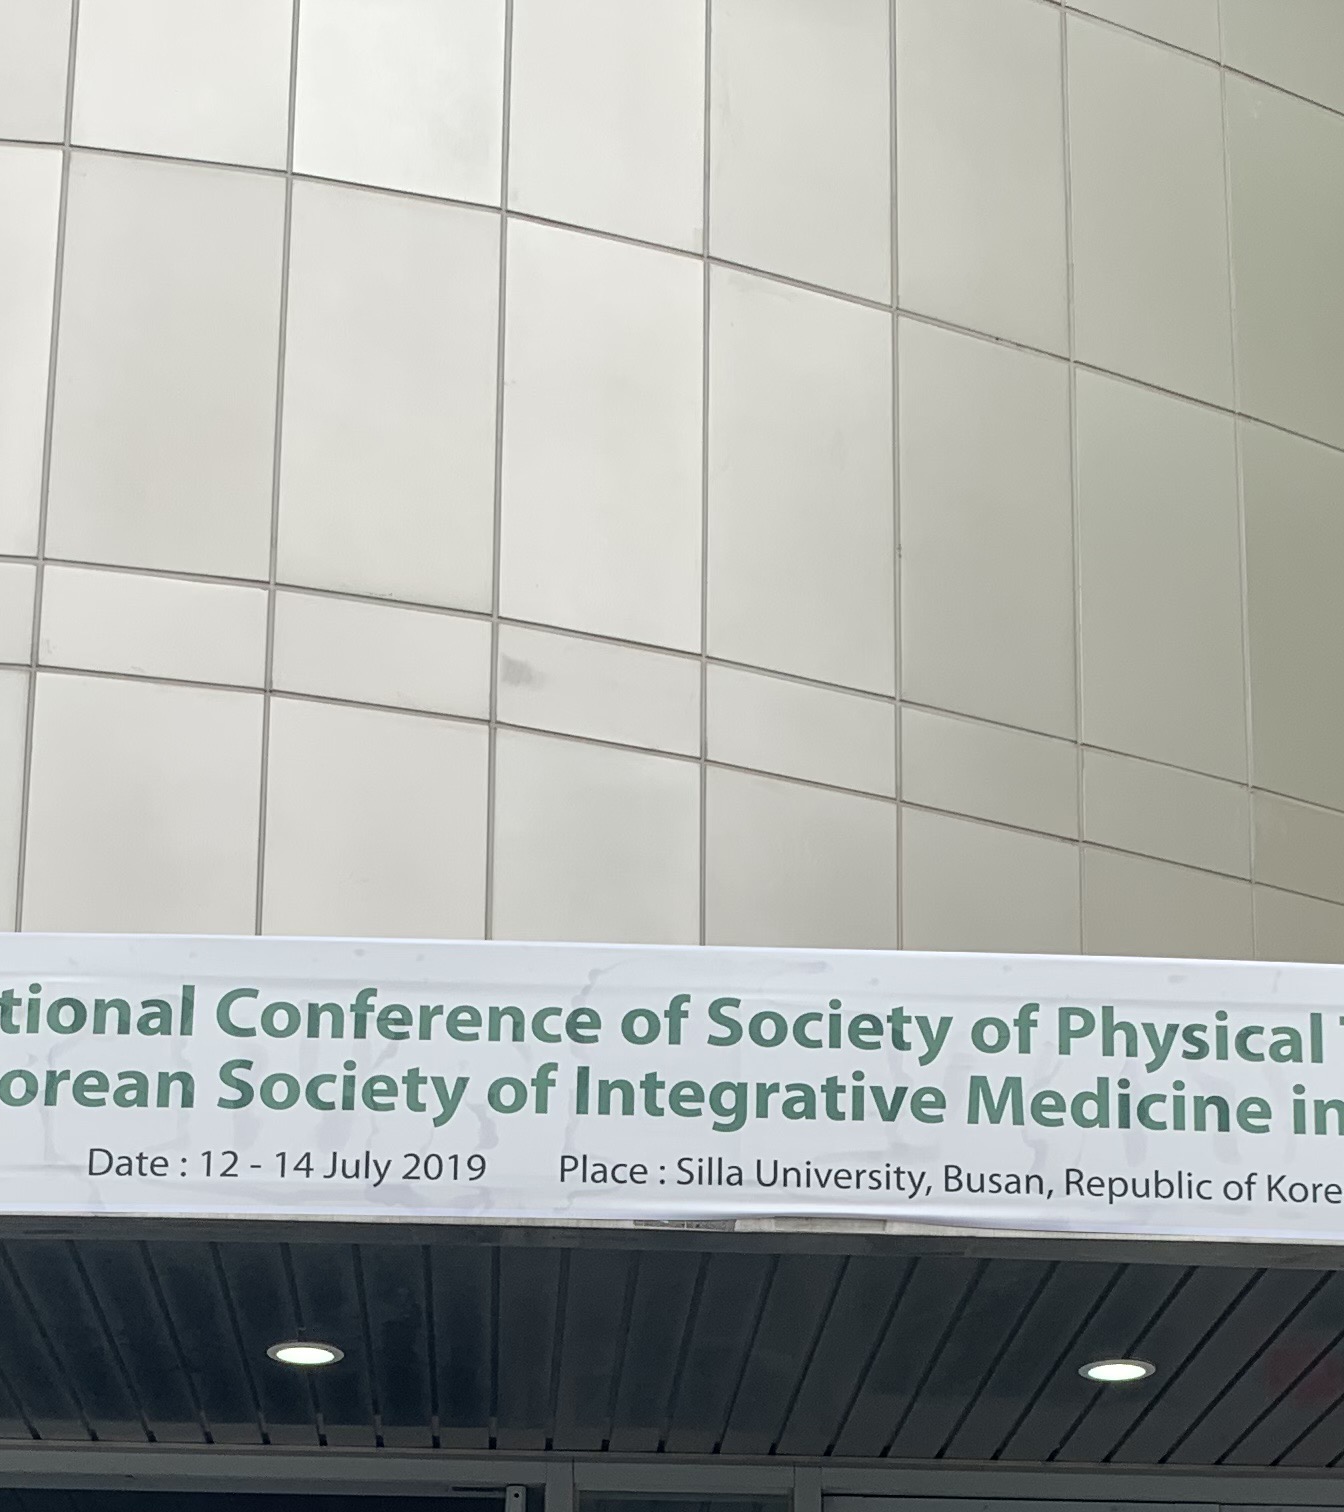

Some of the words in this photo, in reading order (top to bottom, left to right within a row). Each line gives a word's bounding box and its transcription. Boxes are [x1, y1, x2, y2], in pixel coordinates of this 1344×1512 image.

[216, 987, 602, 1045] Conference
[620, 993, 692, 1046] of
[706, 997, 954, 1066] Society
[970, 1002, 1040, 1055] of
[1058, 1005, 1324, 1073] Physical
[216, 1058, 471, 1128] Society
[487, 1061, 559, 1115] of
[575, 1065, 947, 1133] Integrative
[967, 1075, 1272, 1134] Medicine
[88, 1148, 169, 1177] Date
[201, 1150, 239, 1178] 12
[275, 1151, 315, 1179] 14
[323, 1150, 392, 1188] July
[401, 1152, 486, 1181] 2019
[560, 1154, 648, 1185] Place
[676, 1156, 743, 1187] Silla
[756, 1159, 932, 1200] University,
[944, 1164, 1054, 1200] Busan,
[1065, 1168, 1213, 1205] Republic
[1223, 1172, 1258, 1201] of
